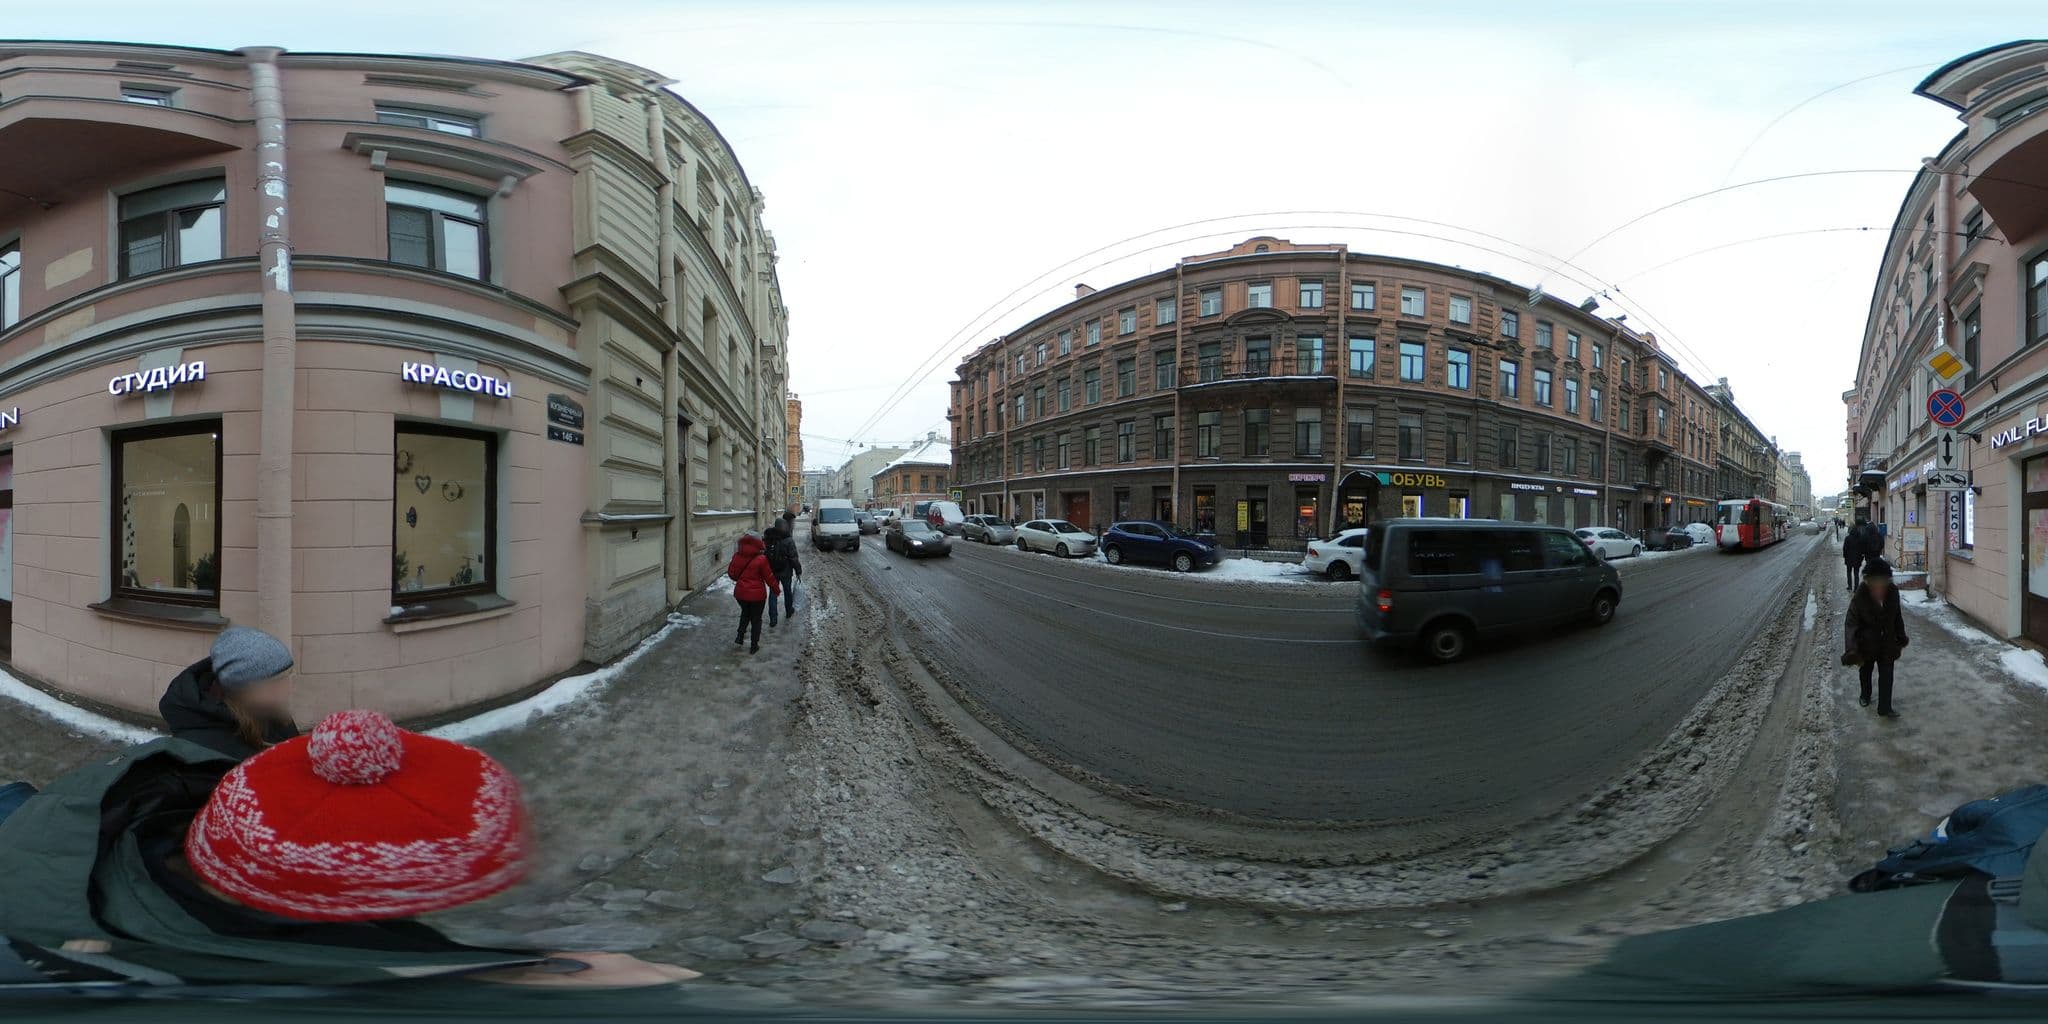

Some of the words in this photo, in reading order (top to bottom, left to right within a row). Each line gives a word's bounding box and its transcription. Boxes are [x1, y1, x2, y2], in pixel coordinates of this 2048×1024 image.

[108, 360, 205, 395] СТУДИЯ
[402, 361, 512, 398] КРАСОТЫ
[1991, 426, 2023, 449] NAIL
[1393, 472, 1446, 487] ОБУВЬ
